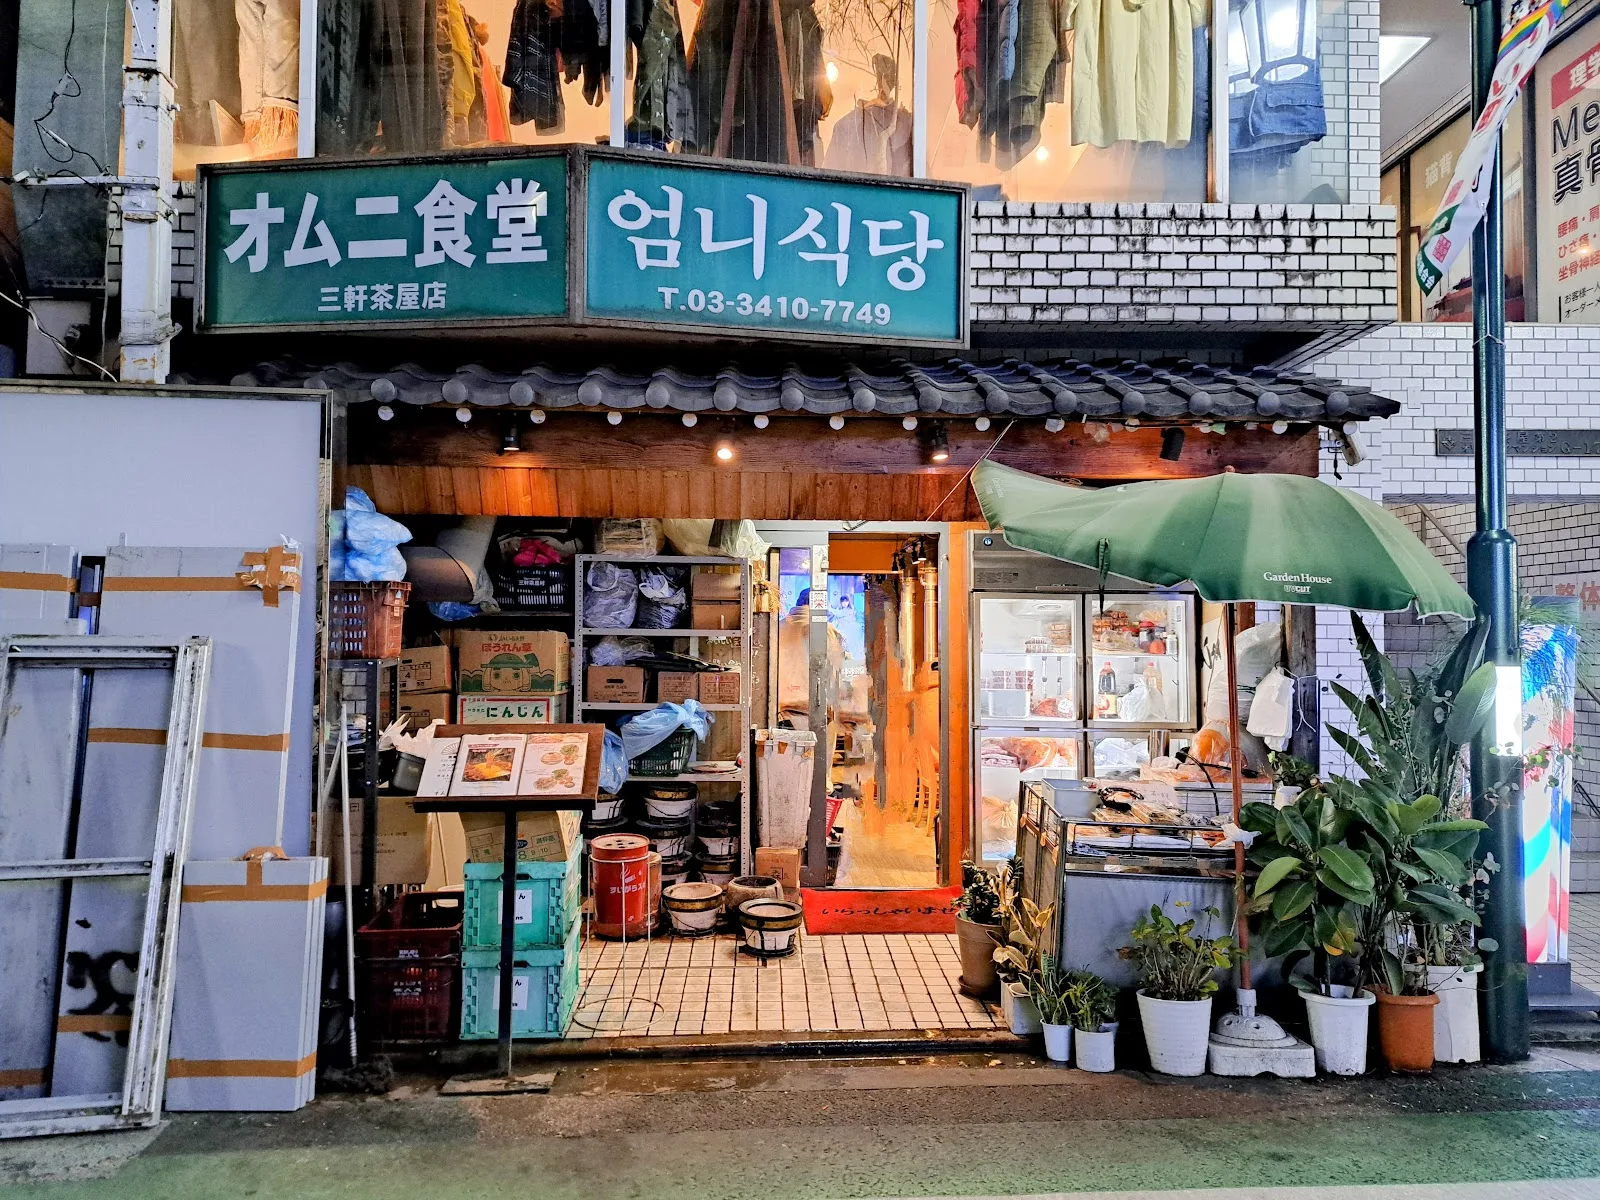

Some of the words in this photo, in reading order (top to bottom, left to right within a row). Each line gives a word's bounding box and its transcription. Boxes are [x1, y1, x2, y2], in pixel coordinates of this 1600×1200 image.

[223, 178, 548, 273] オムニ食堂
[607, 184, 945, 292] 엄니식당
[318, 281, 447, 312] 三軒茶屋店
[657, 286, 892, 326] T.03-3410-7749
[1263, 571, 1300, 582] Garden
[1300, 573, 1332, 584] House
[481, 642, 533, 653] ほうれん草
[486, 706, 543, 718] にんじん
